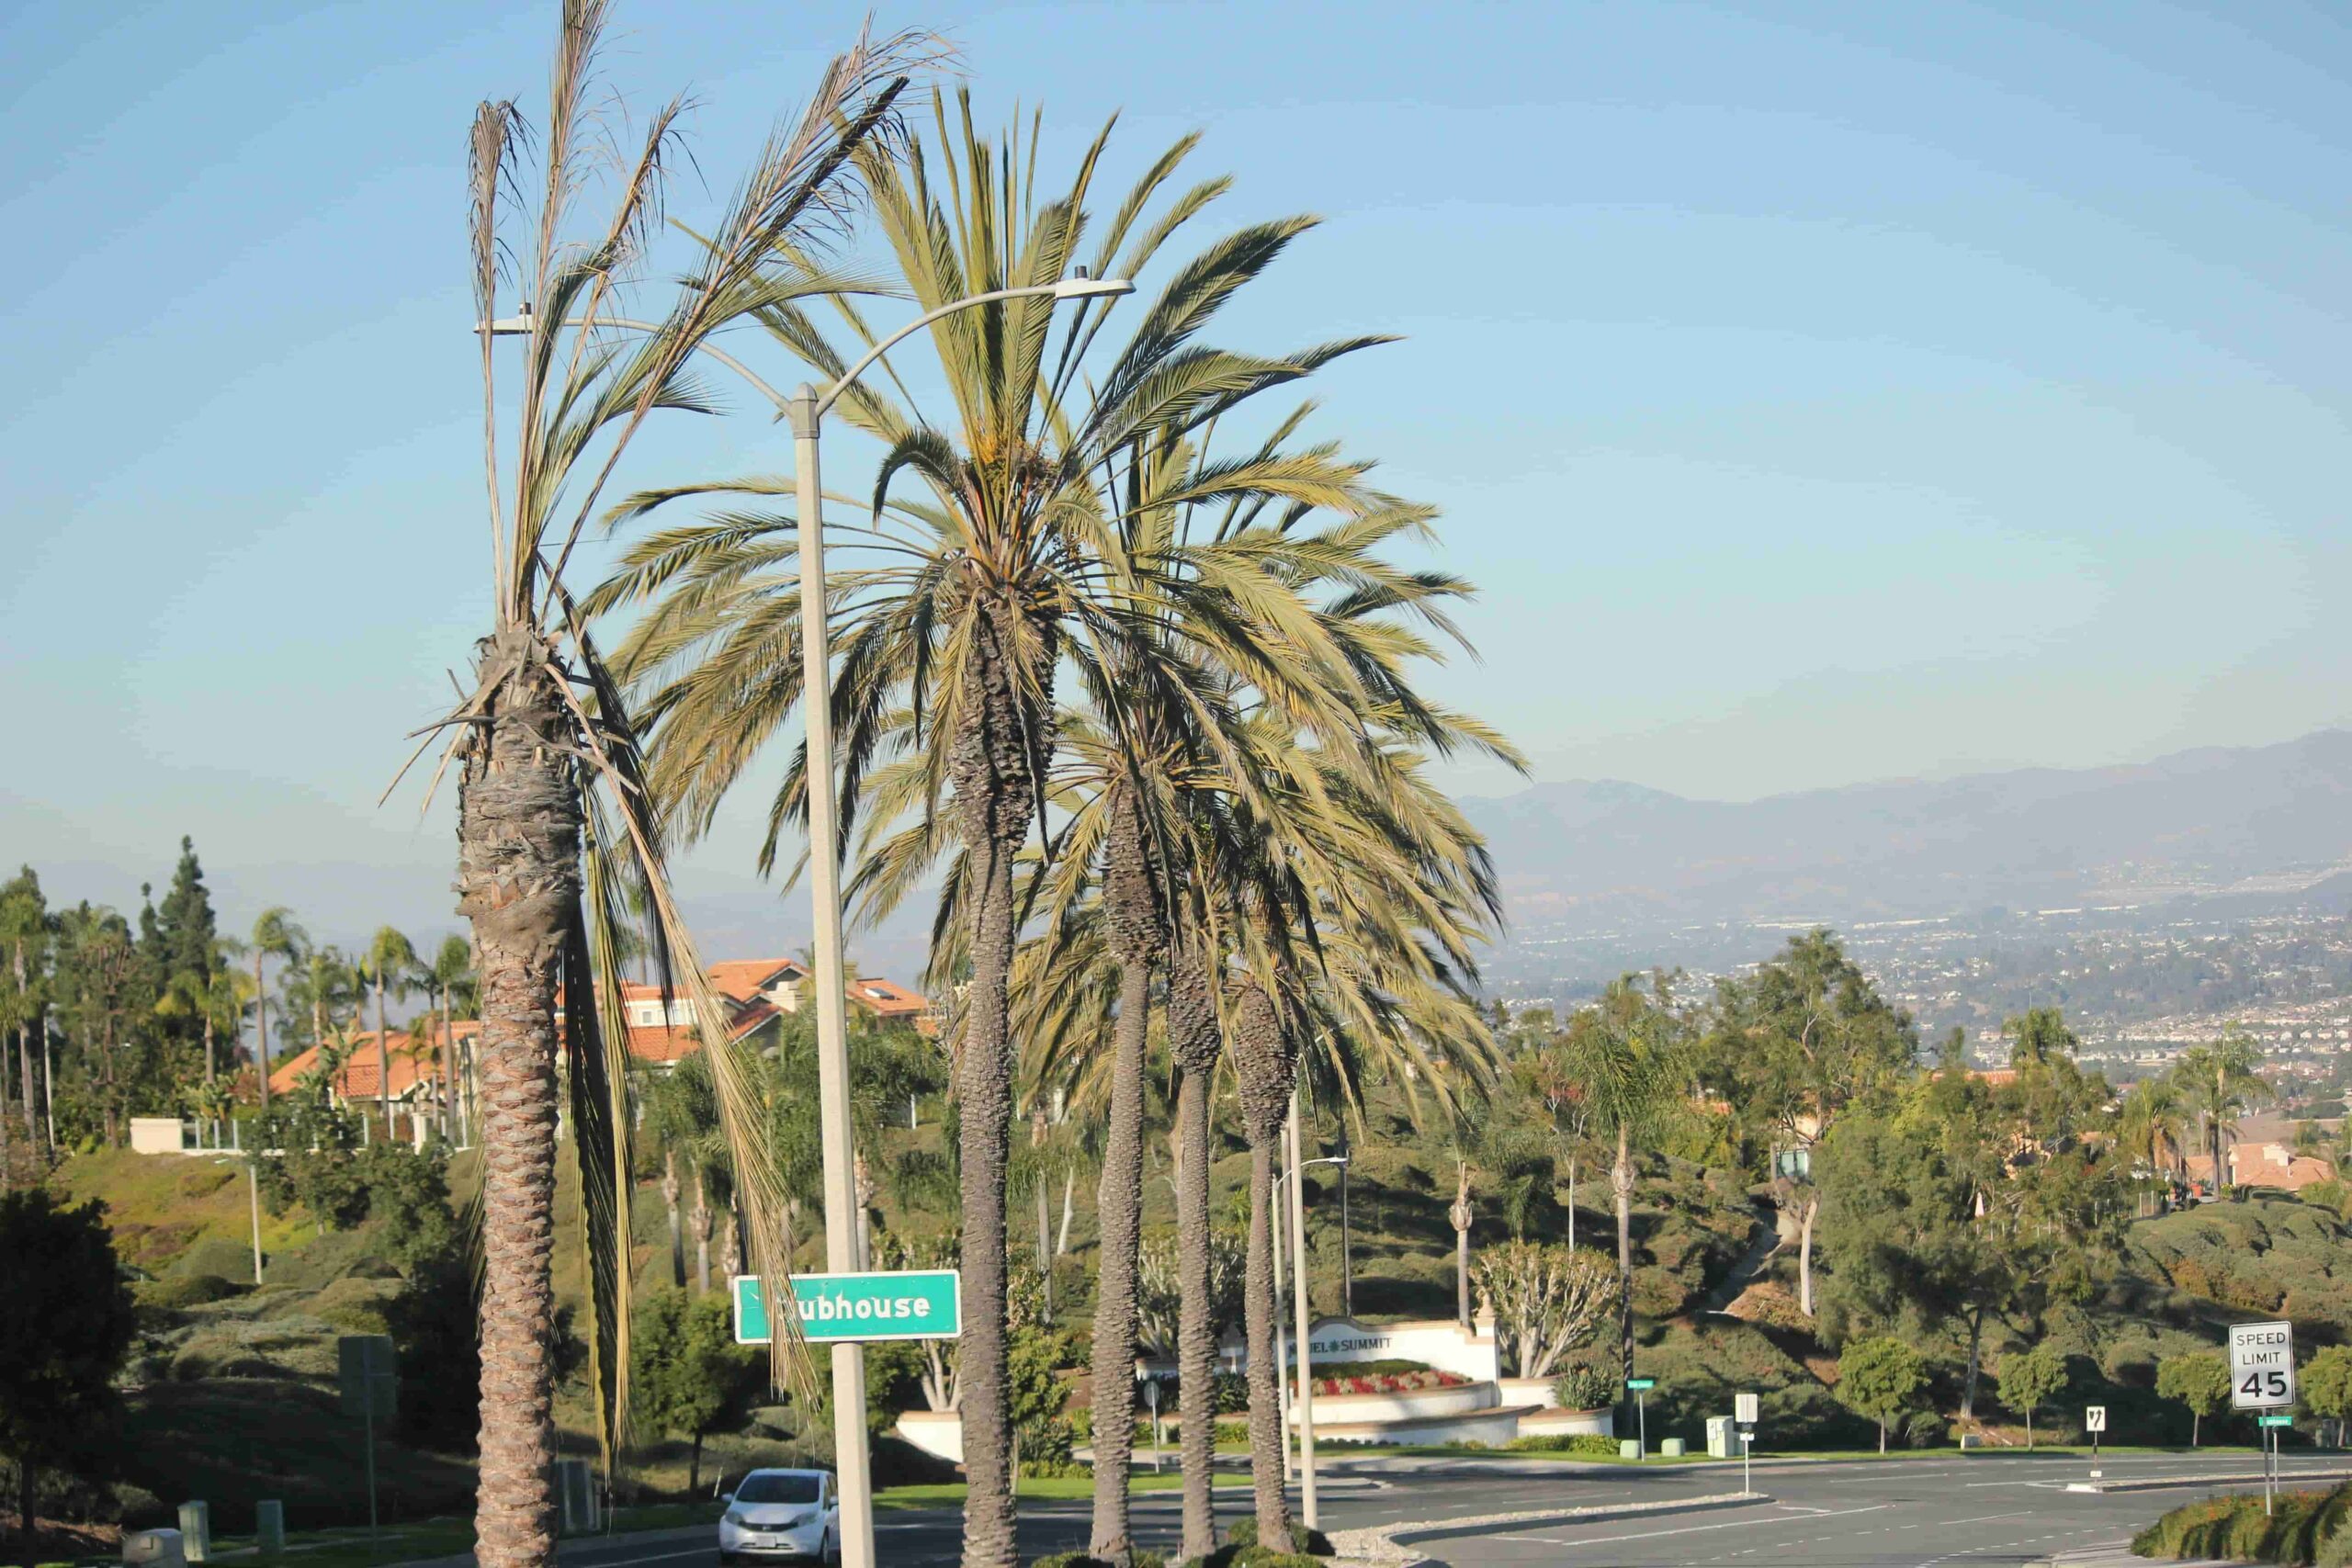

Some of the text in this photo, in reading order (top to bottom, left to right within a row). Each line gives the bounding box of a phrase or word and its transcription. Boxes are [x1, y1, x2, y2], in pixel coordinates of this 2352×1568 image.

[775, 1291, 932, 1320] ubhouse
[1340, 1337, 1392, 1351] SUMMIT
[2236, 1332, 2286, 1346] SPEED
[2243, 1352, 2280, 1365] LIMIT
[2240, 1371, 2287, 1397] 45
